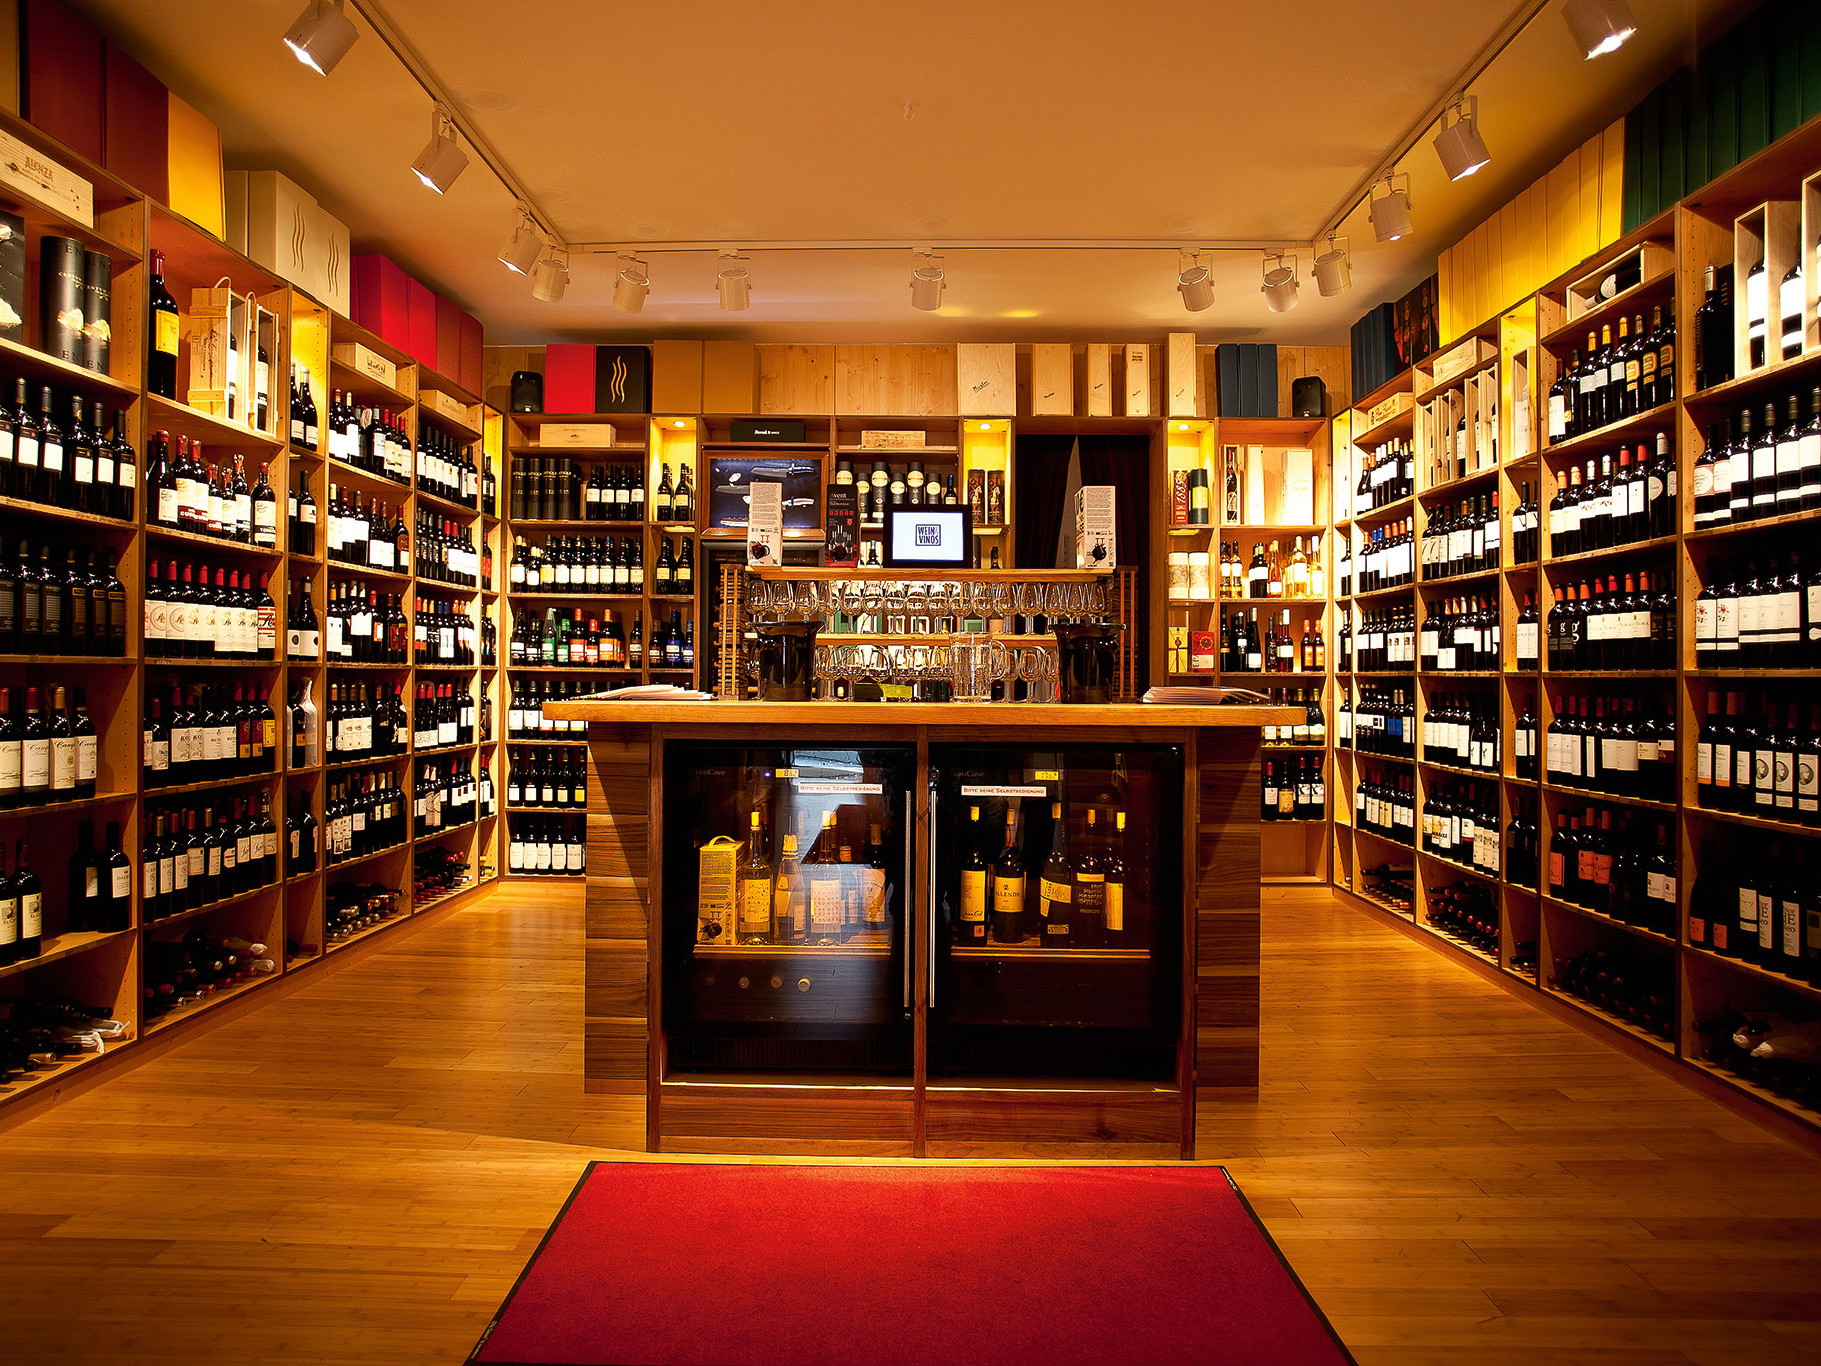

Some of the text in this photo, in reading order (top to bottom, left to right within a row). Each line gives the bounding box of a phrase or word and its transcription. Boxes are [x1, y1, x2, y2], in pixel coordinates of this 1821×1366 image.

[1175, 477, 1187, 503] 1885
[917, 526, 935, 535] WEIN
[918, 535, 939, 545] VINOS
